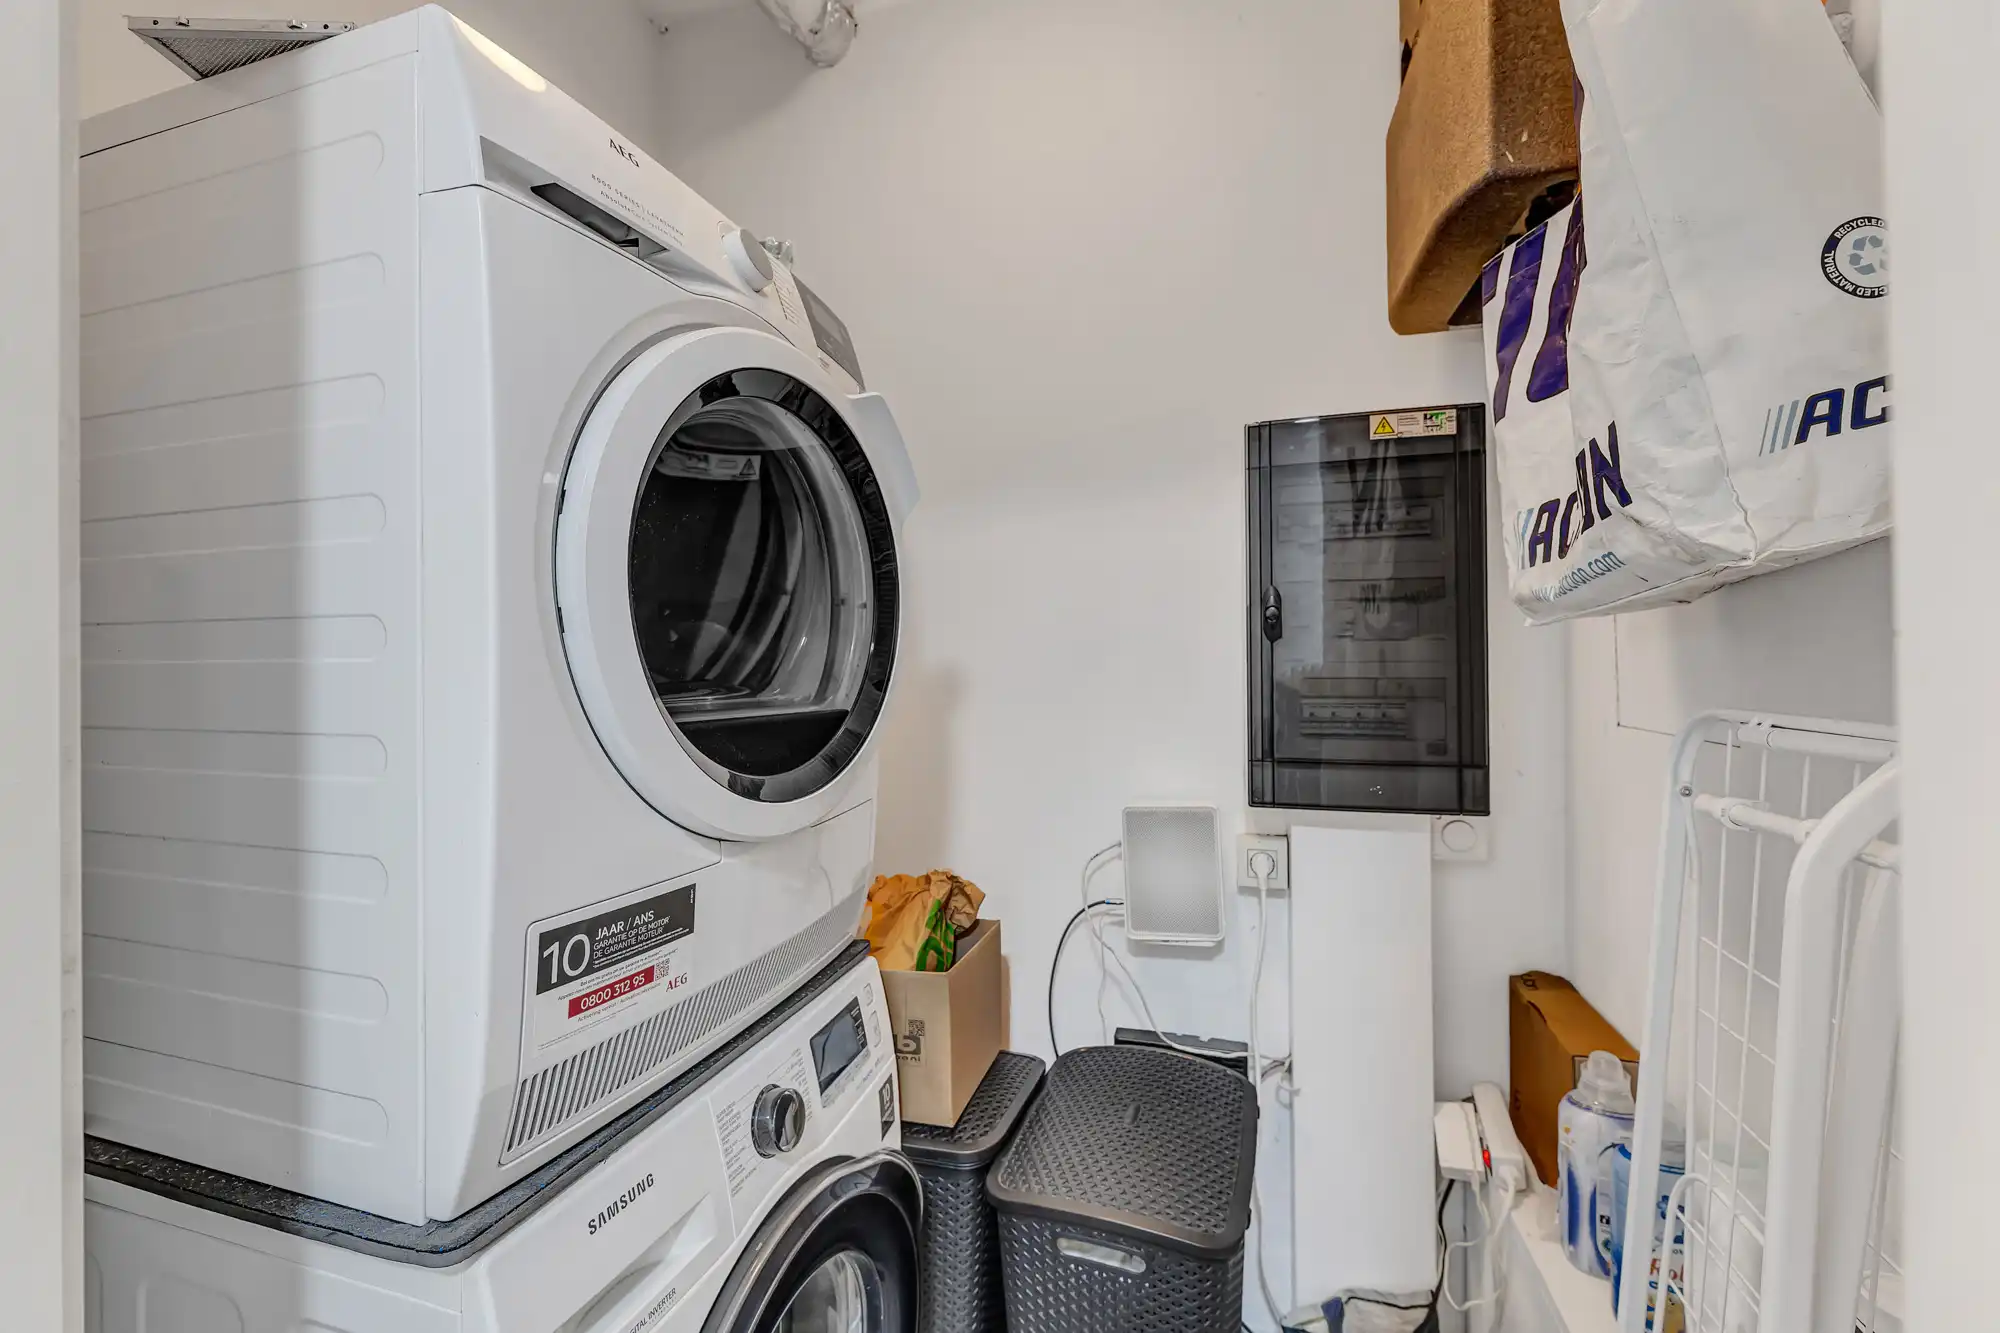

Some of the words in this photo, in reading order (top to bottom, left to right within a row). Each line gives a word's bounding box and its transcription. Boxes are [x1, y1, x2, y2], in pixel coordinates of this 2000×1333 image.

[609, 138, 640, 168] AEG
[1834, 218, 1885, 239] RECYCLED
[1824, 250, 1856, 292] MATERIAL
[594, 931, 628, 950] GARANTIE
[628, 927, 638, 938] OP
[638, 924, 648, 934] DE
[596, 920, 624, 940] JAAR
[633, 910, 655, 928] ANS
[543, 934, 590, 984] 10
[594, 950, 603, 959] DE
[604, 938, 637, 956] GARANTIE
[580, 988, 612, 1010] 0800
[613, 980, 630, 997] 312
[632, 973, 645, 988] 95
[666, 972, 688, 992] AEG
[588, 1172, 656, 1236] SAMSUNG
[648, 1287, 676, 1320] INVERTER
